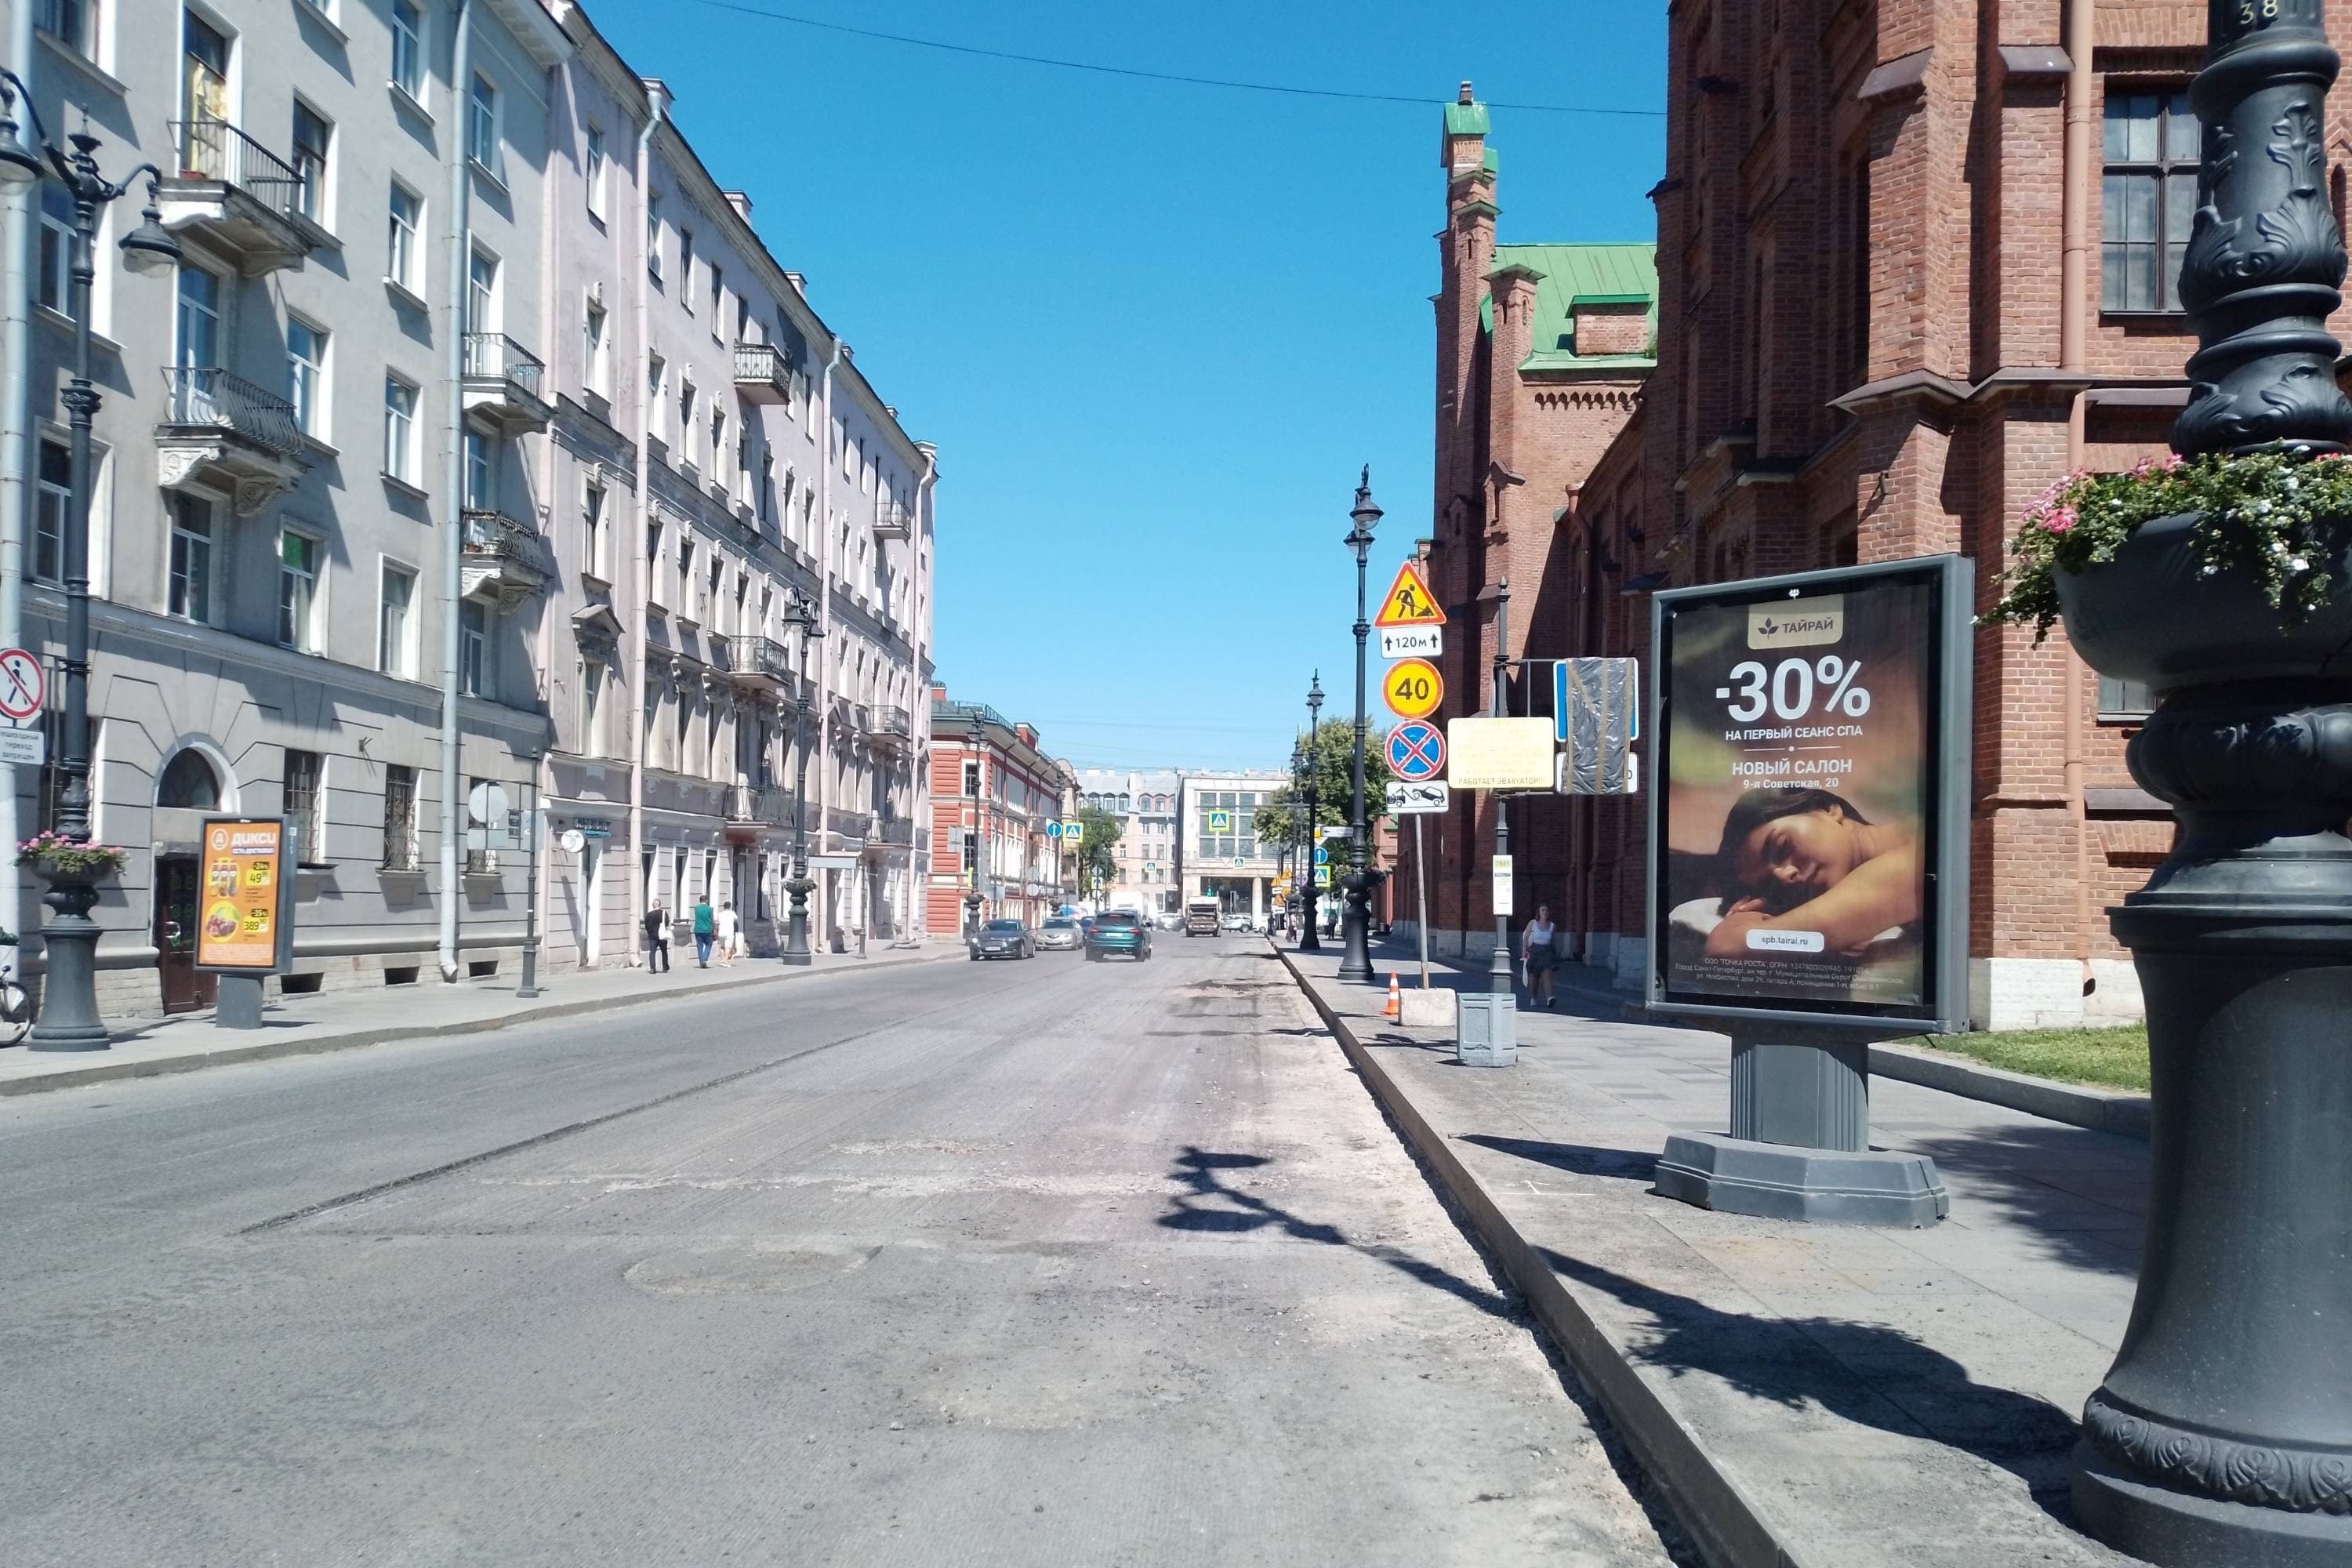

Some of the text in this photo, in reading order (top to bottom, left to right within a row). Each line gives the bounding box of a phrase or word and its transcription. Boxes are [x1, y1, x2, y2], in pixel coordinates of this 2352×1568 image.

[2240, 0, 2278, 24] 38
[1782, 617, 1834, 633] ТАЙРАЙ
[1396, 637, 1427, 648] 120м
[1395, 677, 1429, 700] 40
[1715, 655, 1871, 722] -30%
[1726, 725, 1863, 741] НА ПЕРВЫЙ СЕАНС СПА
[1732, 758, 1852, 775] НОВЫЙ САЛОН
[1743, 778, 1839, 789] 9-я Советская, 20
[1761, 935, 1808, 946] spb.tairai.ru
